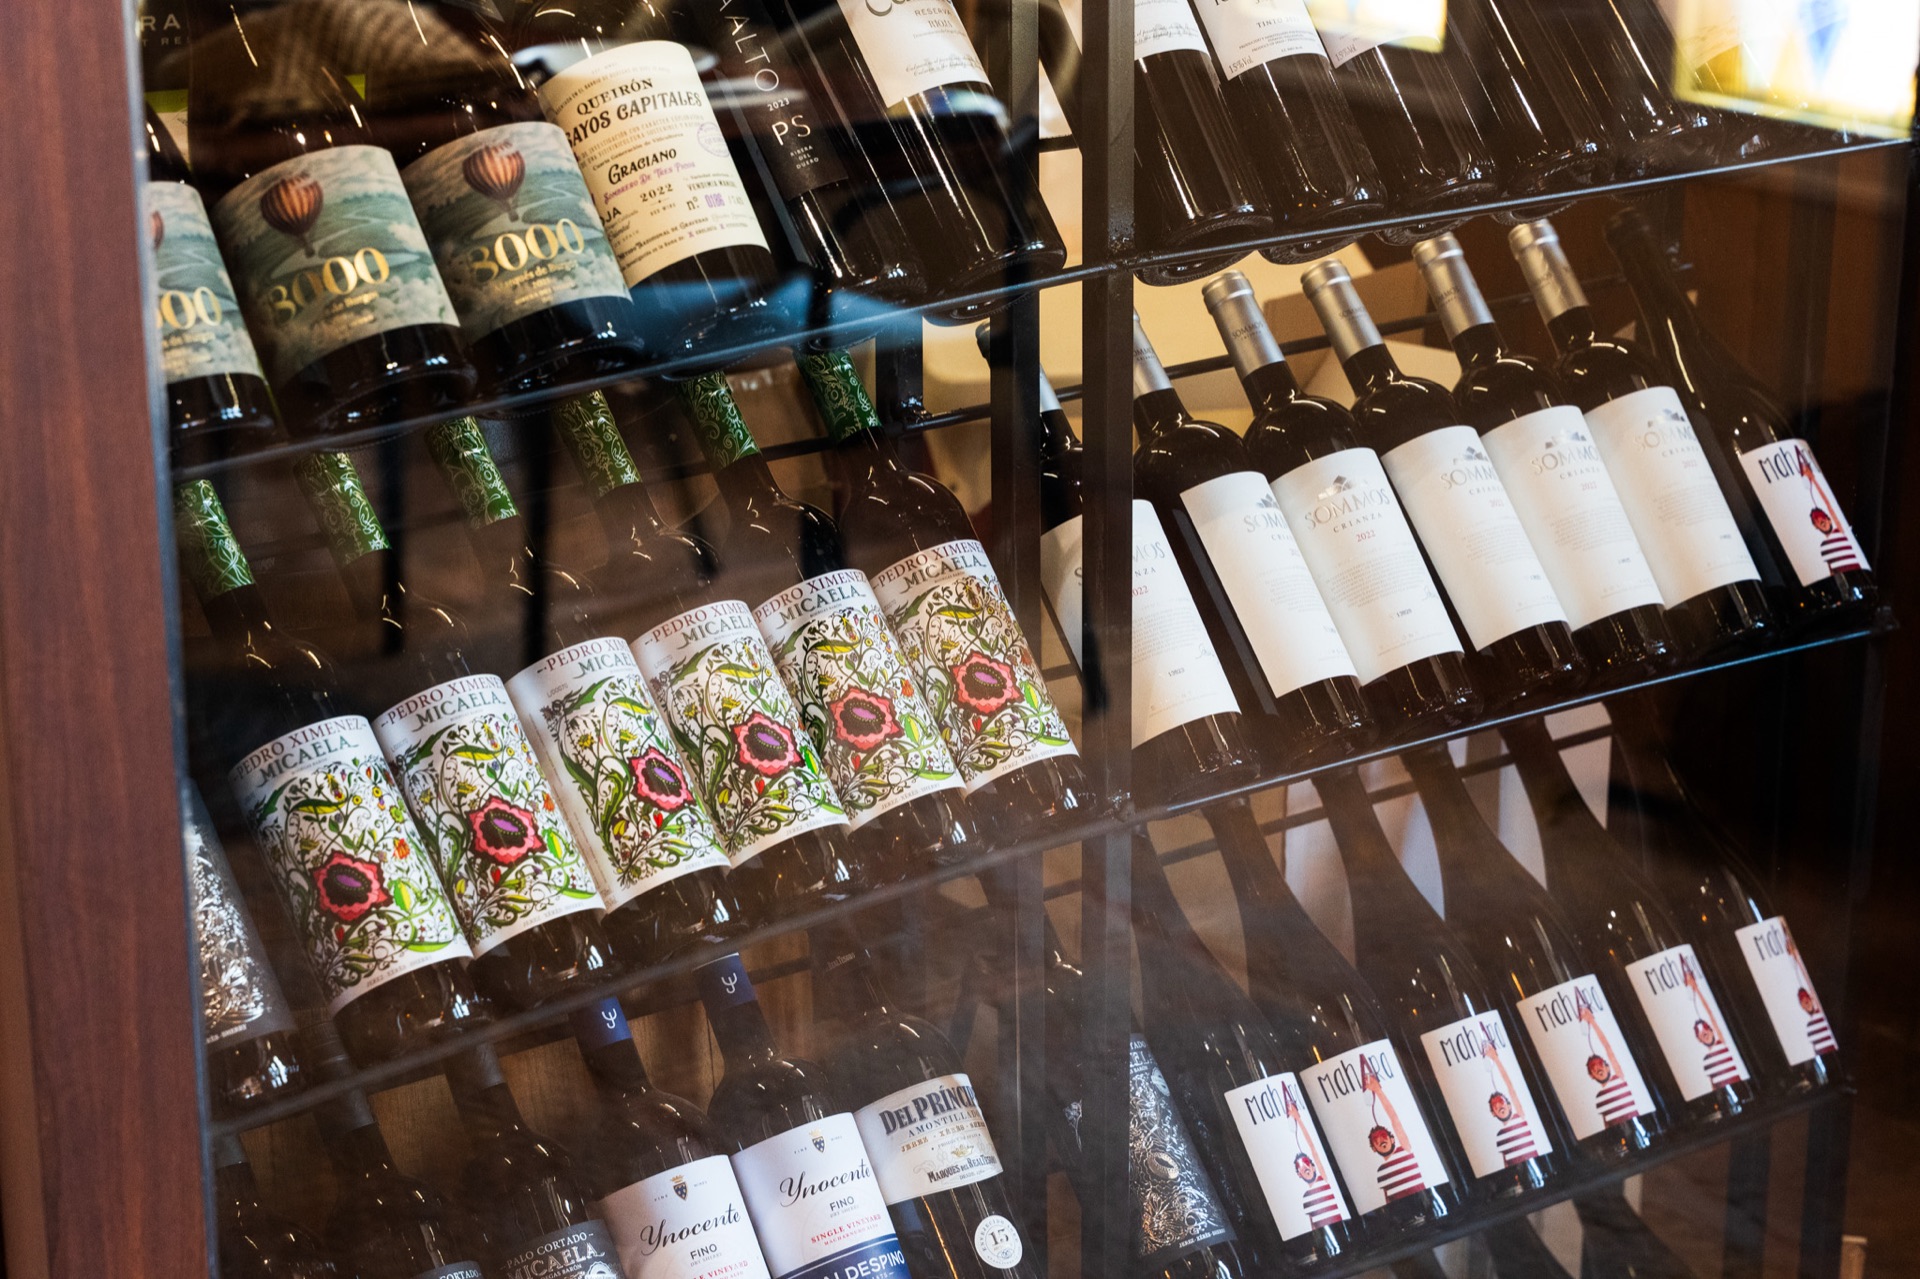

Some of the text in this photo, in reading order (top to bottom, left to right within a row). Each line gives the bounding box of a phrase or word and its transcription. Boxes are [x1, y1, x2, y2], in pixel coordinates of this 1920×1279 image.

[576, 78, 654, 116] QUEIRÓN
[616, 90, 703, 121] CAPITALES
[767, 97, 790, 111] 2023
[772, 115, 811, 146] PS
[607, 149, 677, 185] GRACIANO
[796, 157, 819, 169] DUERO
[798, 152, 811, 161] DEL
[640, 182, 674, 203] 2022
[468, 218, 585, 281] 3000
[270, 247, 389, 320] 3000
[156, 286, 222, 329] 00
[1305, 488, 1391, 530] SOMMOS
[1333, 512, 1383, 533] CRIANZA
[1356, 530, 1376, 542] 2022
[879, 553, 928, 587] PEDRO
[900, 554, 987, 594] MICAELA
[755, 588, 803, 622] PEDRO
[777, 584, 866, 630] MICAELA
[652, 610, 706, 643] PEDRO
[677, 616, 758, 651] MICAELA
[546, 641, 602, 672] PEDRO
[387, 688, 443, 726] PEDRO
[412, 690, 506, 732] MICAELA
[237, 744, 285, 775] PEDRO
[291, 718, 362, 746] XIMENEZ
[258, 735, 359, 787] MICAELA
[780, 1158, 871, 1208] Ynocente
[830, 1196, 854, 1211] FINO
[640, 1202, 741, 1256] Ynocente
[811, 1213, 881, 1244] SINGLE VINEYARD
[989, 1228, 1009, 1245] 15
[507, 1232, 587, 1268] PALO CORTADO
[690, 1243, 718, 1260] FINO
[562, 1264, 582, 1274] BARÓN
[707, 1260, 748, 1278] VINEYARD
